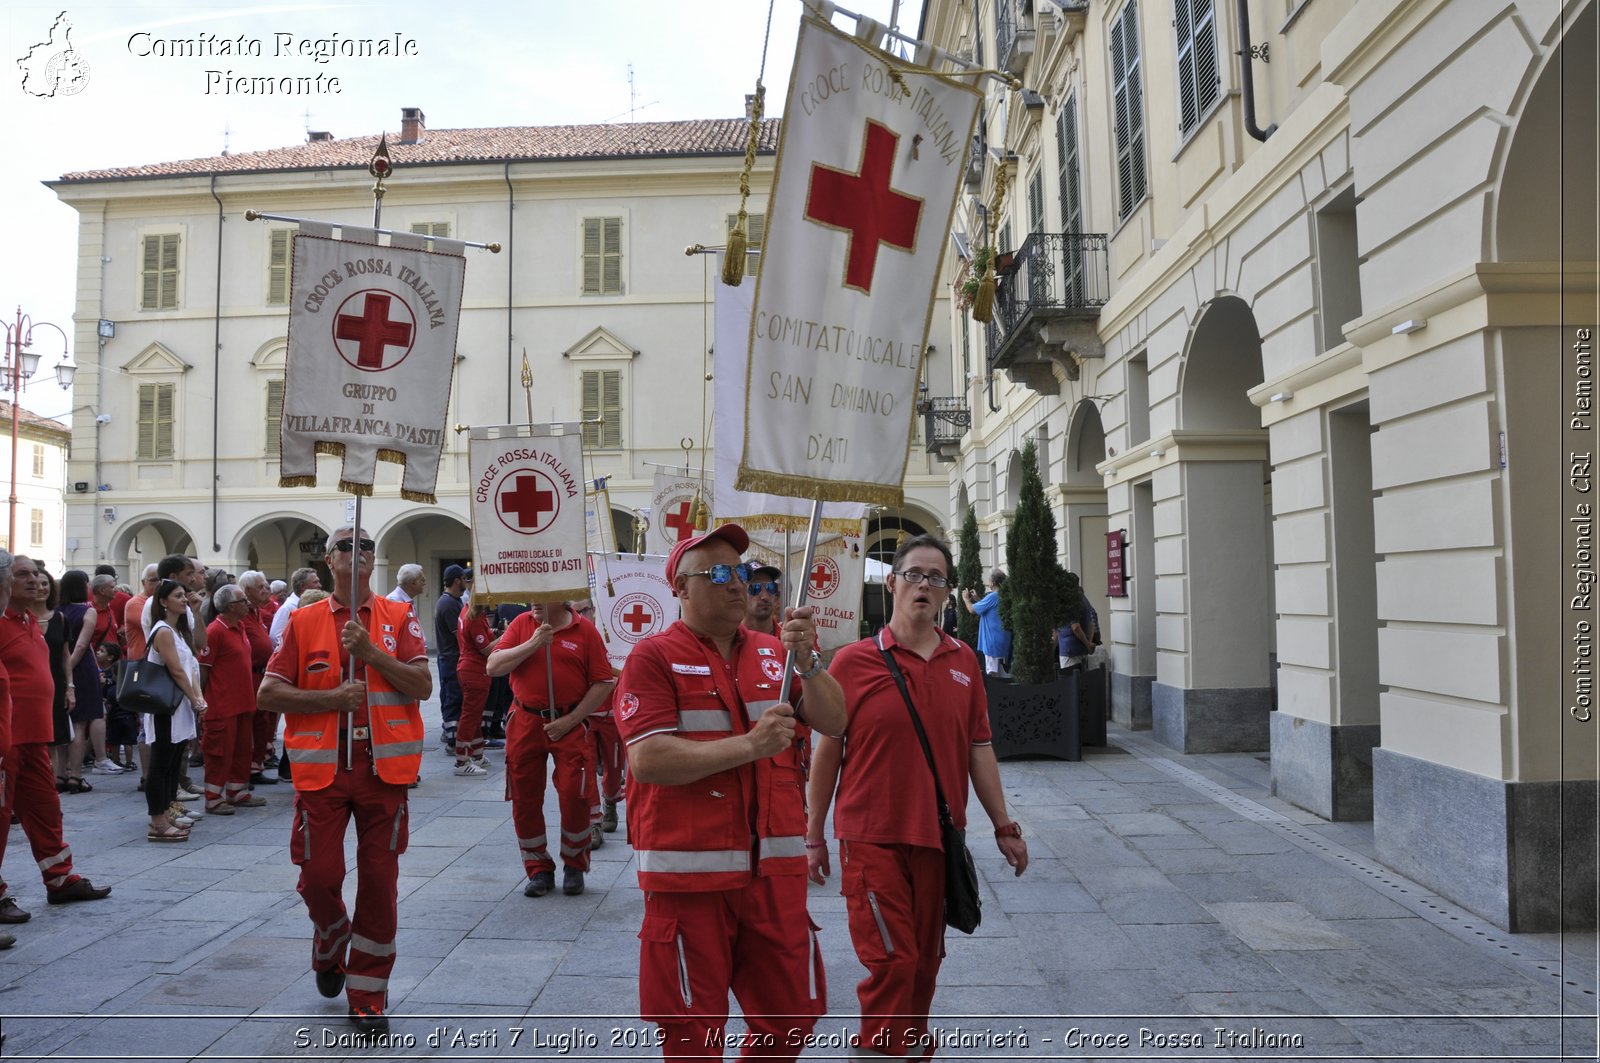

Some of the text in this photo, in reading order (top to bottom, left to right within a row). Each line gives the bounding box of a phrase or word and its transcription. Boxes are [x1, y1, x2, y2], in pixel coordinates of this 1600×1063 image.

[800, 63, 850, 116] CROCE
[910, 86, 960, 166] ITALIANA
[304, 258, 445, 330] CROCE ROSSA ITALIANA
[756, 311, 920, 370] COMITATO LOCALE
[342, 382, 397, 402] GRUPPO
[768, 371, 812, 405] SAN
[362, 403, 374, 415] DI
[285, 414, 441, 446] VILLAFRANCA D'ASTI
[476, 448, 578, 503] CROCE ROSSA ITALIANA
[480, 558, 582, 576] MONTEGROSSO D'ASTI
[498, 548, 563, 560] COMITATO LOCALE DI
[824, 607, 855, 621] LOCALE
